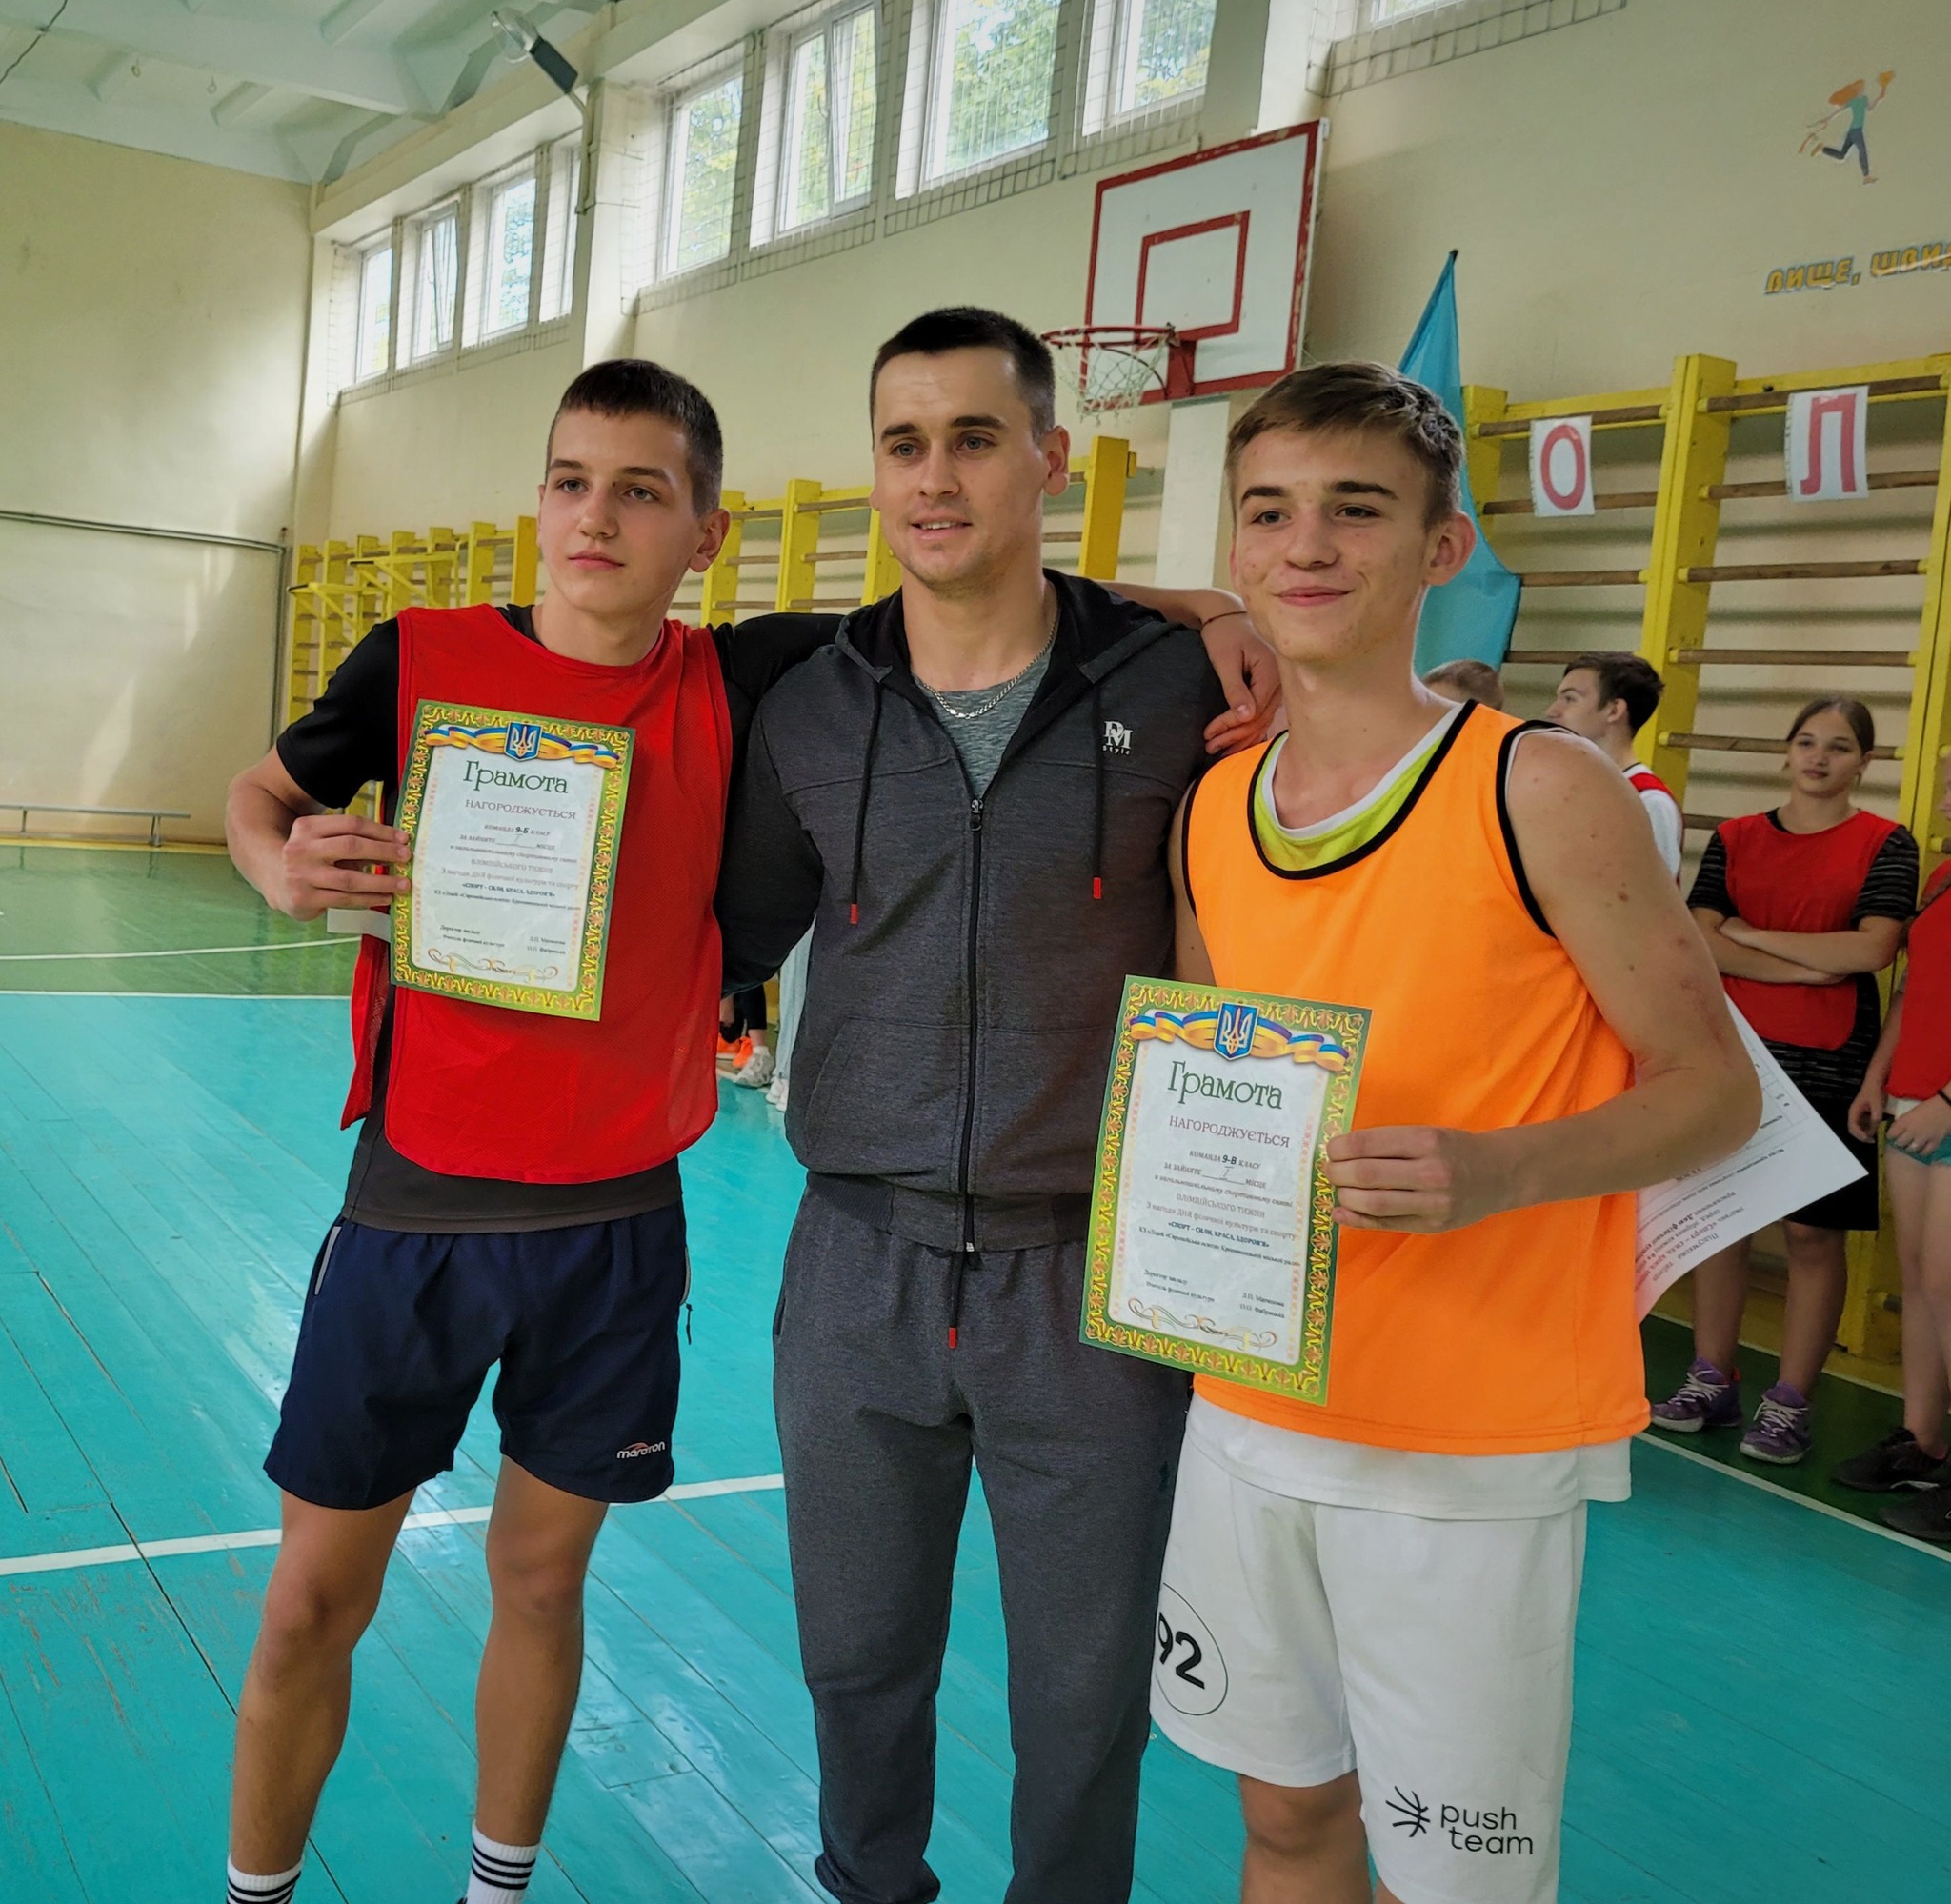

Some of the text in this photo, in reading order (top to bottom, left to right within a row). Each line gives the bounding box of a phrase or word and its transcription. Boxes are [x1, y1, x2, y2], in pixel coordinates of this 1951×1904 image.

[1540, 393, 1858, 511] О Л
[463, 760, 568, 793] Грамота
[465, 799, 576, 820] НАГОРОДЖУЄТЬСЯ
[1167, 1060, 1282, 1110] Грамота
[1169, 1115, 1290, 1148] НАГОРОДЖУЄТЬСЯ
[1221, 1154, 1237, 1165] 9-В
[1158, 1612, 1205, 1689] 92
[1440, 1803, 1517, 1831] push
[1448, 1827, 1534, 1854] team
